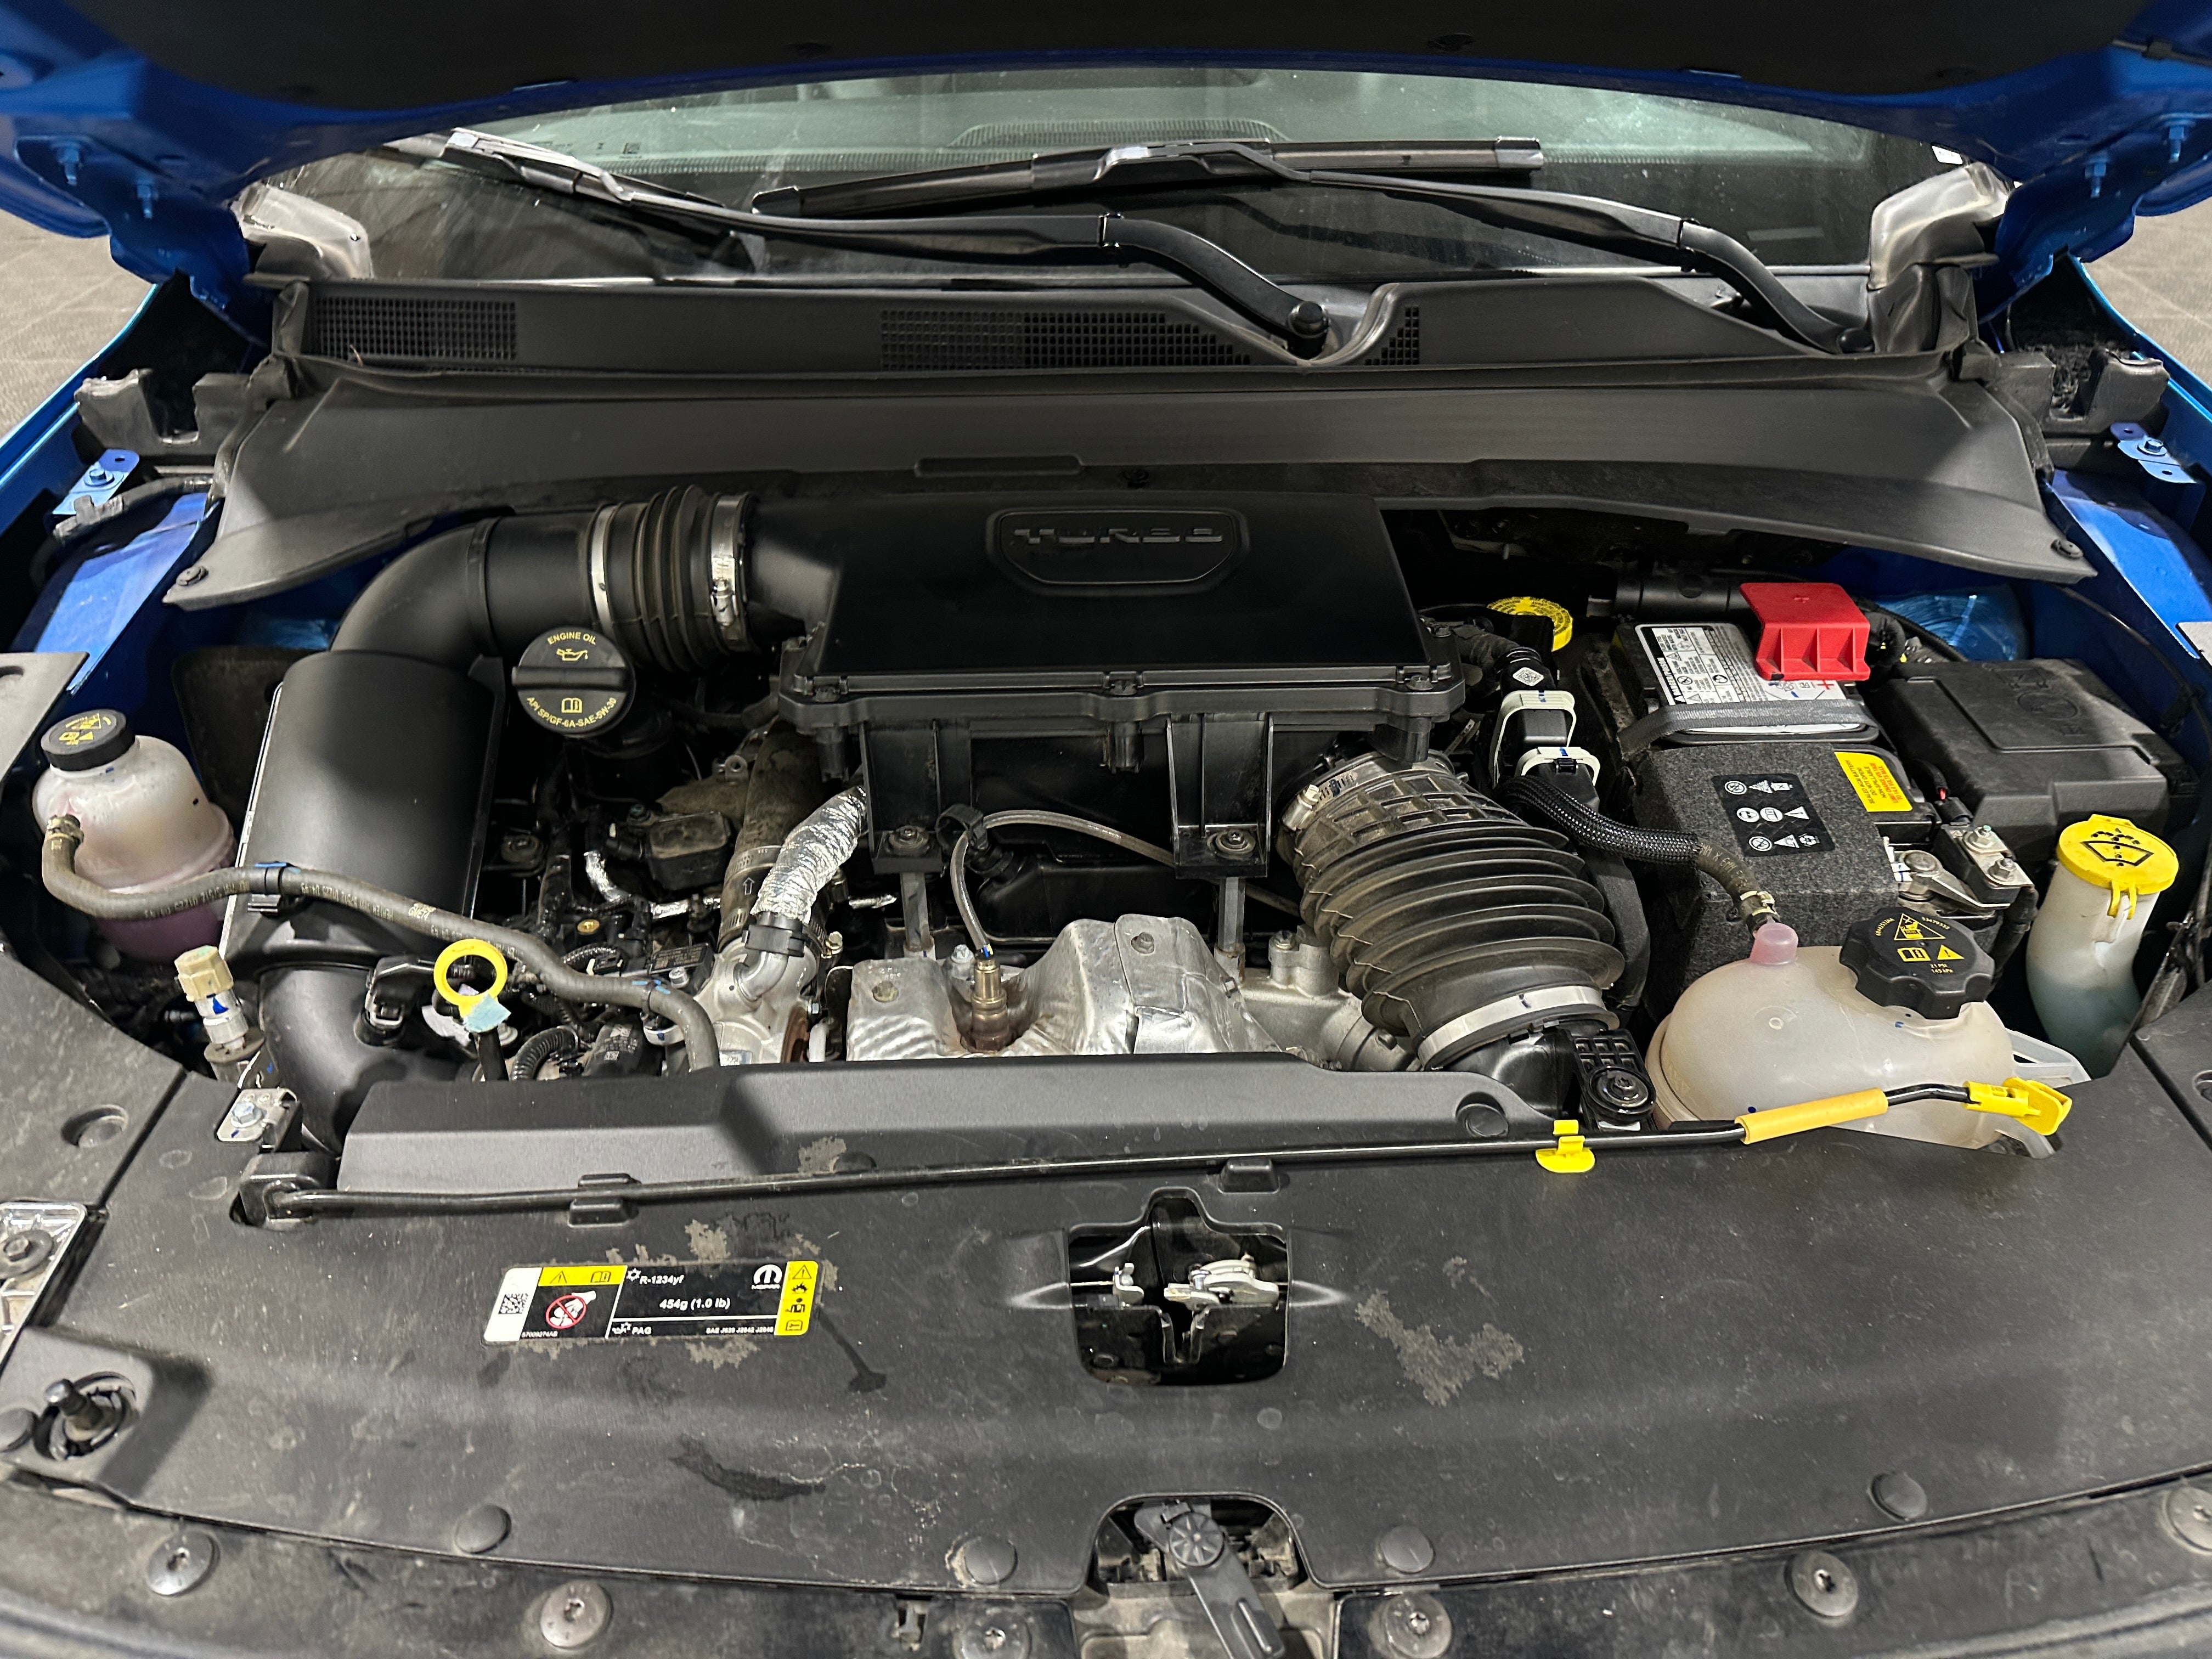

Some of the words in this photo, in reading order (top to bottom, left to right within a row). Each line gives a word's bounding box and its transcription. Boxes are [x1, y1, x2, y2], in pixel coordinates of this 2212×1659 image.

[1014, 527, 1223, 544] TURBO
[548, 632, 581, 645] ENGINE
[583, 634, 596, 645] OIL
[527, 697, 540, 711] API
[1845, 760, 1859, 777] BATTERY
[639, 1274, 684, 1285] R-1234yf
[659, 1299, 688, 1311] 454g
[690, 1297, 712, 1310] (1.0
[715, 1297, 731, 1310] lb)
[632, 1327, 652, 1335] PAG
